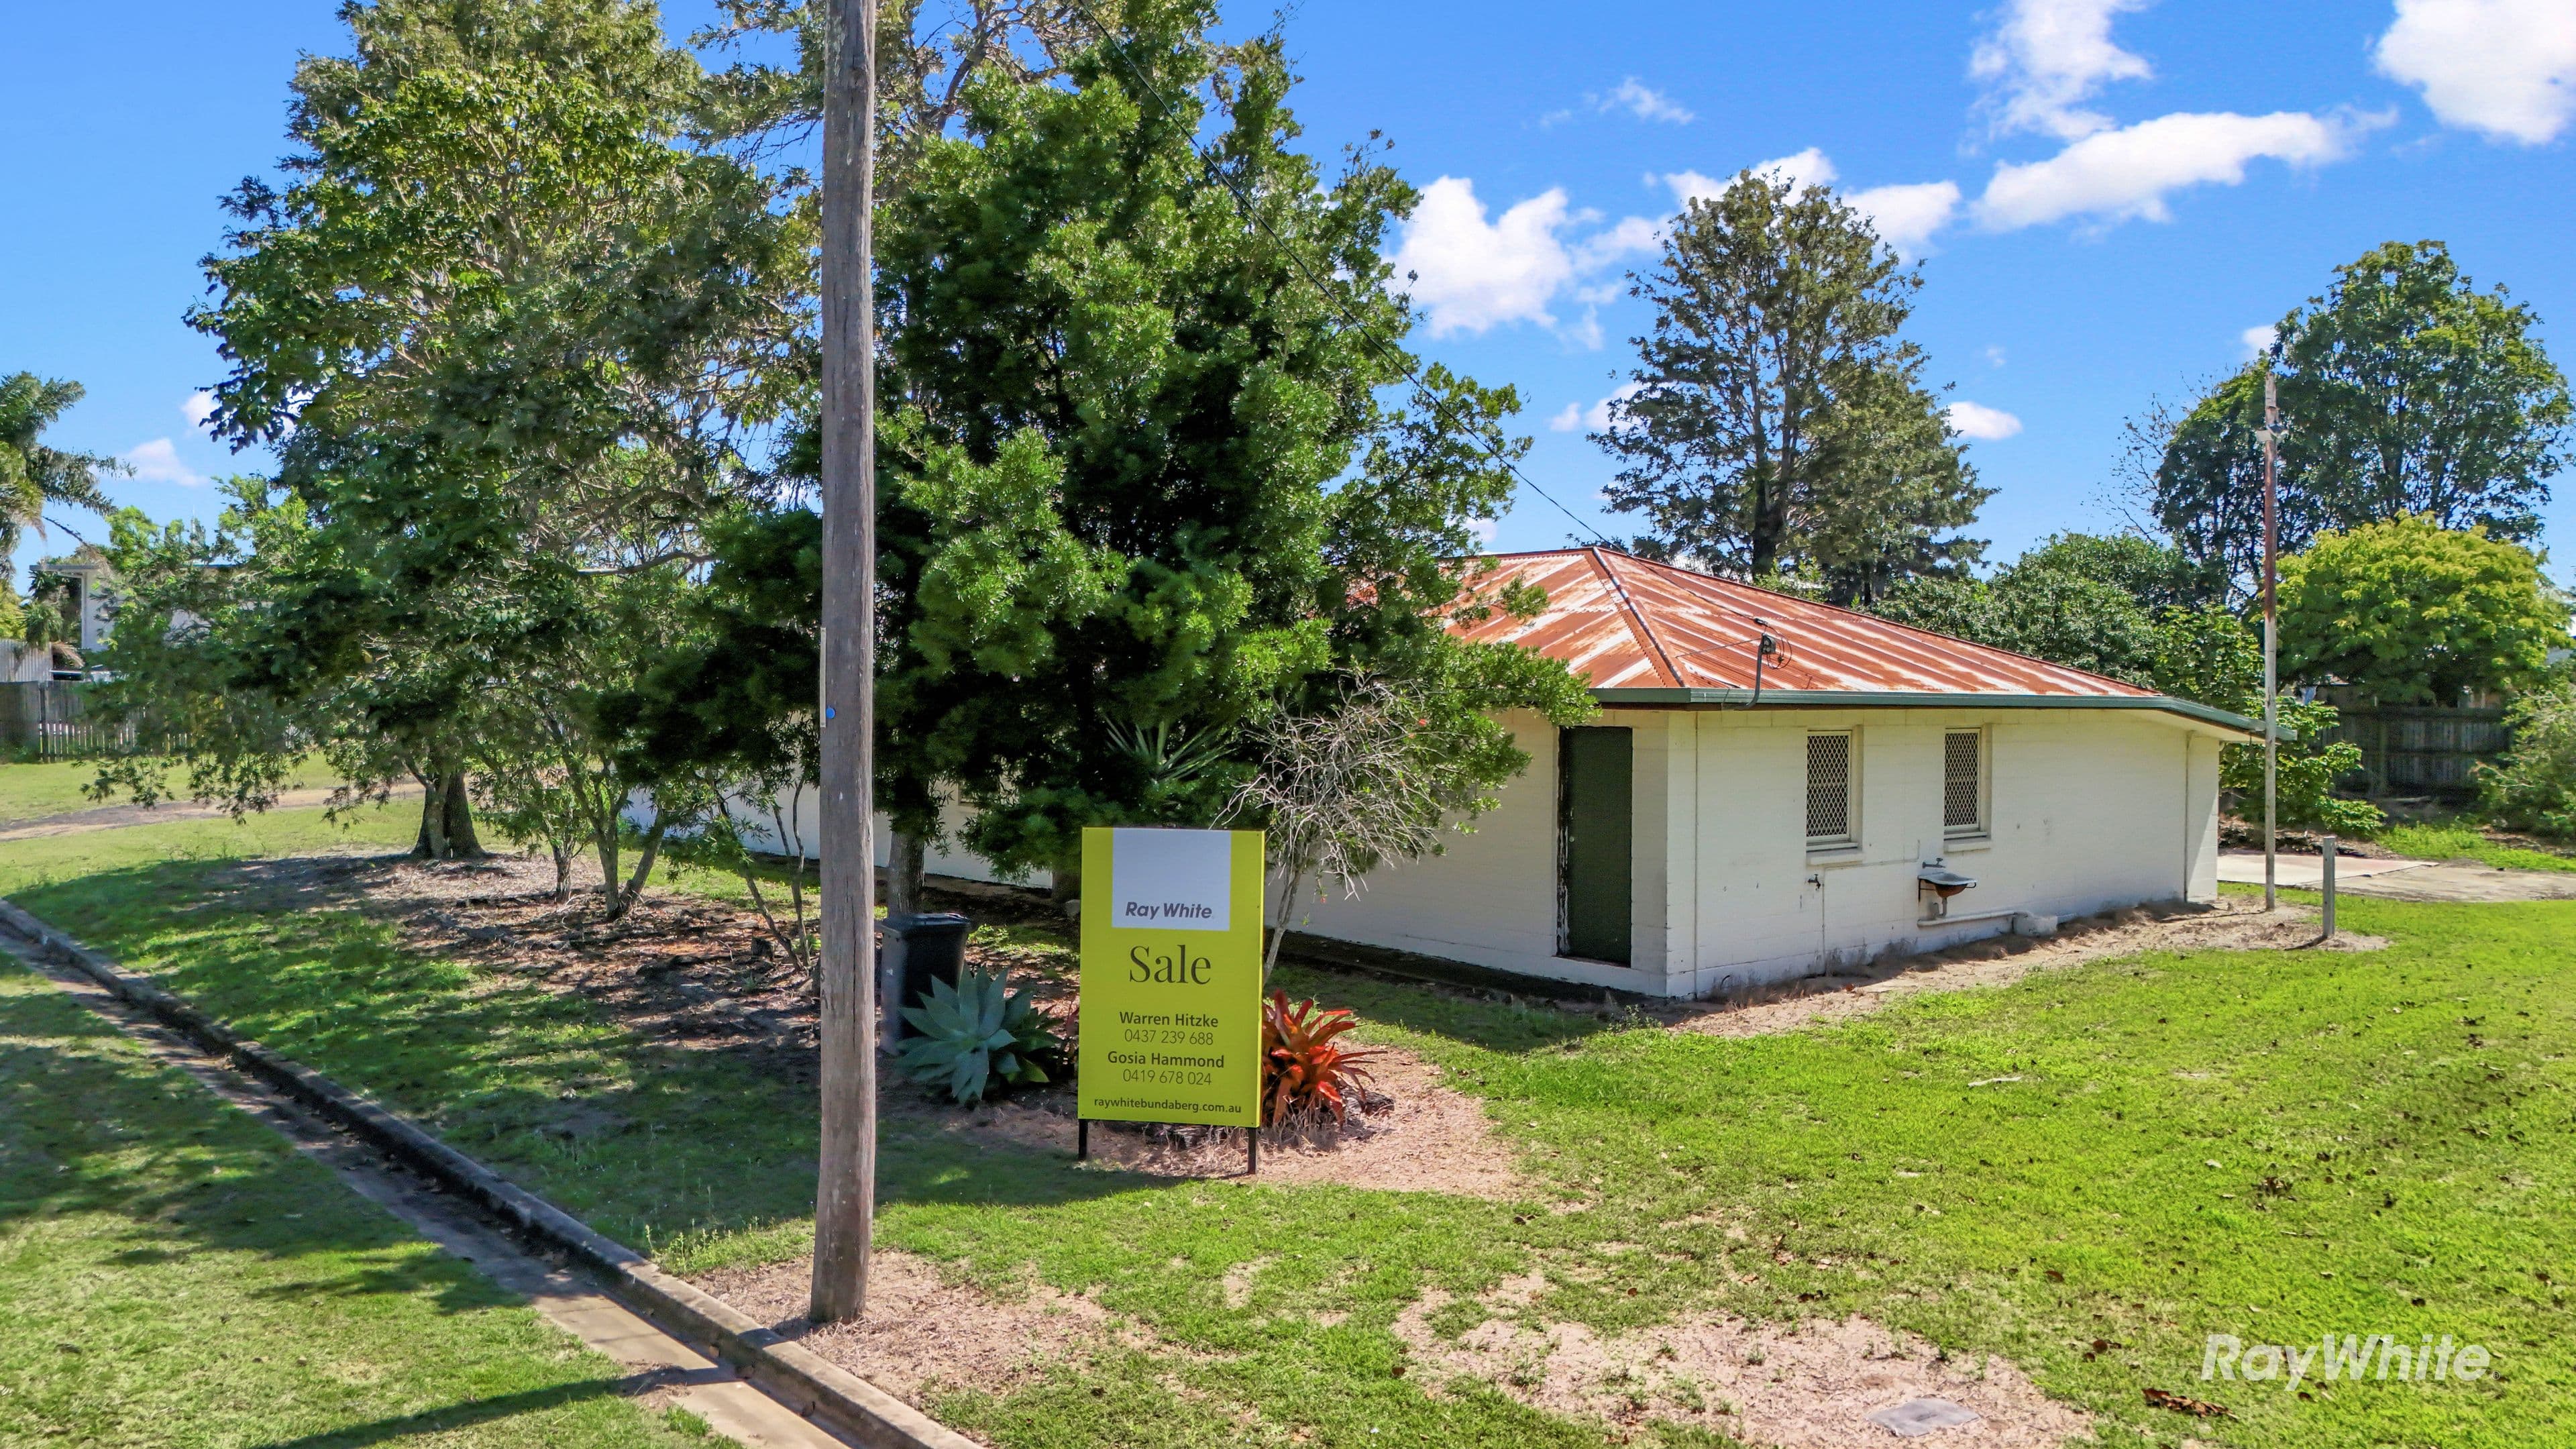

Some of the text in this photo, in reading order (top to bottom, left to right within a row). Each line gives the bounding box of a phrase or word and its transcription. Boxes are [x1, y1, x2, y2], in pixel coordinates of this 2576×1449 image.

[1125, 901, 1212, 920] Ray White
[1129, 944, 1211, 985] Sale
[1119, 1011, 1219, 1028] Warren Hitzke
[1124, 1028, 1214, 1046] 0437 239 688
[1108, 1051, 1224, 1069] Gosia Hammond
[1122, 1069, 1212, 1085] 0419 678 024
[1094, 1097, 1242, 1114] raywhitebundaberg.com.au
